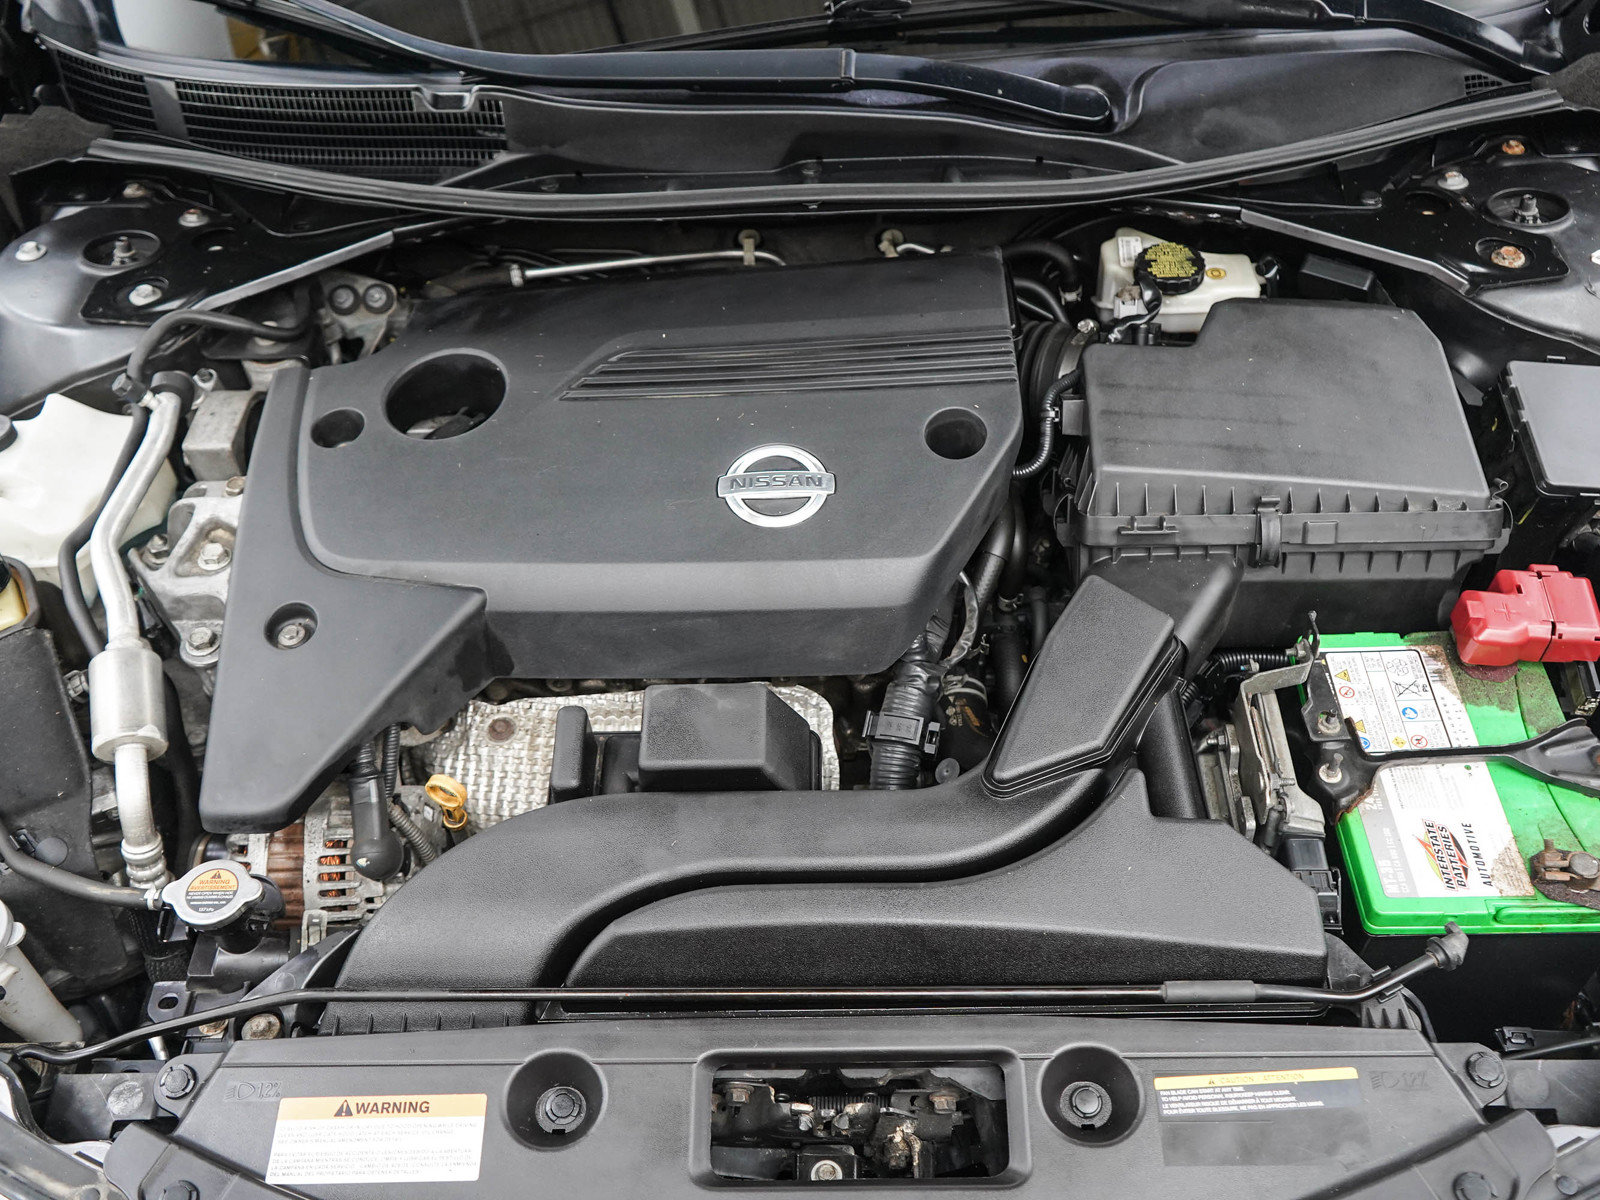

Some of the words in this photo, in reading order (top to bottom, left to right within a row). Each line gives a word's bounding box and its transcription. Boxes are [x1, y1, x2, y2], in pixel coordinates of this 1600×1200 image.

[729, 474, 823, 490] NISSAN
[1424, 821, 1456, 890] INTERSTATE
[1437, 825, 1467, 888] BATTERIES
[1461, 822, 1493, 887] AUTOMOTIVE
[356, 1101, 430, 1114] WARNING
